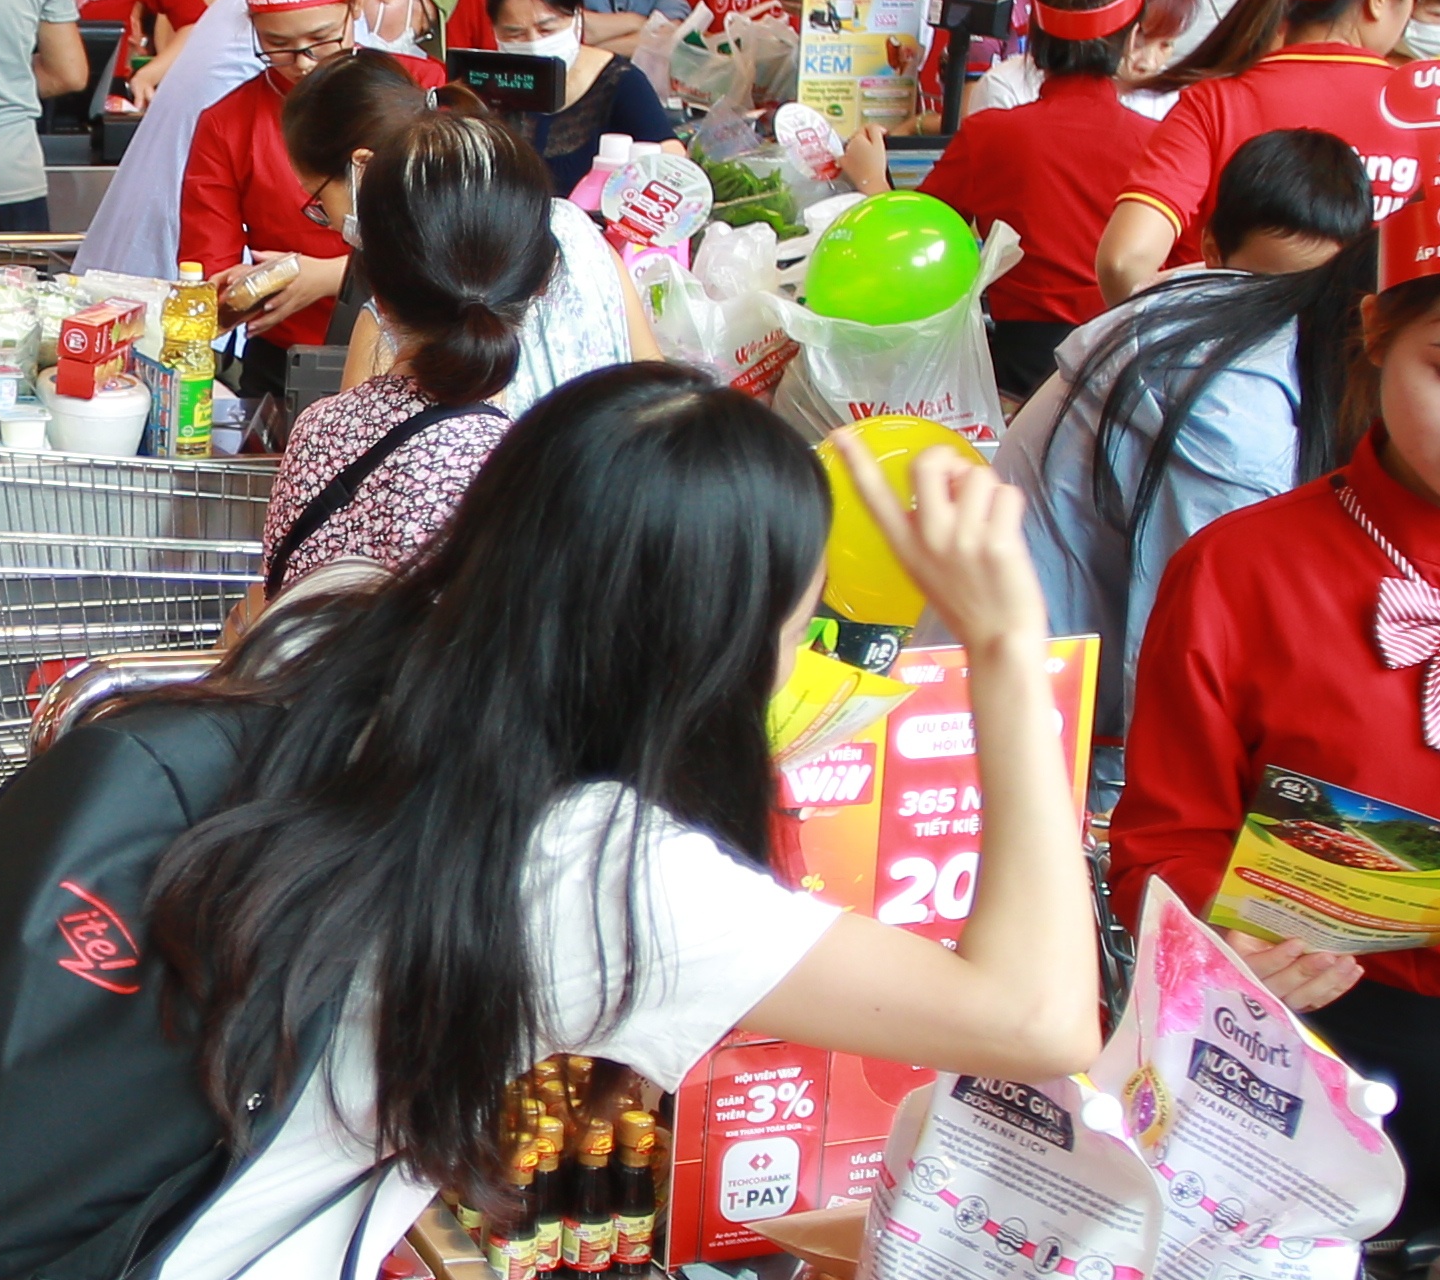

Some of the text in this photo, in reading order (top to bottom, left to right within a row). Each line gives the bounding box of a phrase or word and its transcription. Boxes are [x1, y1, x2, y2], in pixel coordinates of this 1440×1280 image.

[805, 56, 852, 74] KEM
[1414, 245, 1435, 262] ÁP
[828, 745, 863, 762] VIÊN
[898, 787, 958, 817] 365
[913, 815, 981, 837] TIẾT KIỆ
[64, 909, 137, 972] itel
[1213, 1006, 1292, 1069] Comfort
[734, 1069, 777, 1085] HỘI VIÊN
[716, 1094, 745, 1108] GIẢM
[962, 1091, 1004, 1120] DƯỠNG
[973, 1076, 1064, 1125] NƯỚC GIẶT
[1248, 1080, 1292, 1114] GIẶT
[715, 1109, 746, 1122] THÊM
[1193, 1091, 1269, 1140] THANH LỊCH
[740, 1127, 765, 1137] THANH
[971, 1113, 1049, 1157] THANH LỊCH
[727, 1172, 792, 1188] TECHCOMBANK
[726, 1184, 791, 1211] T-PAY
